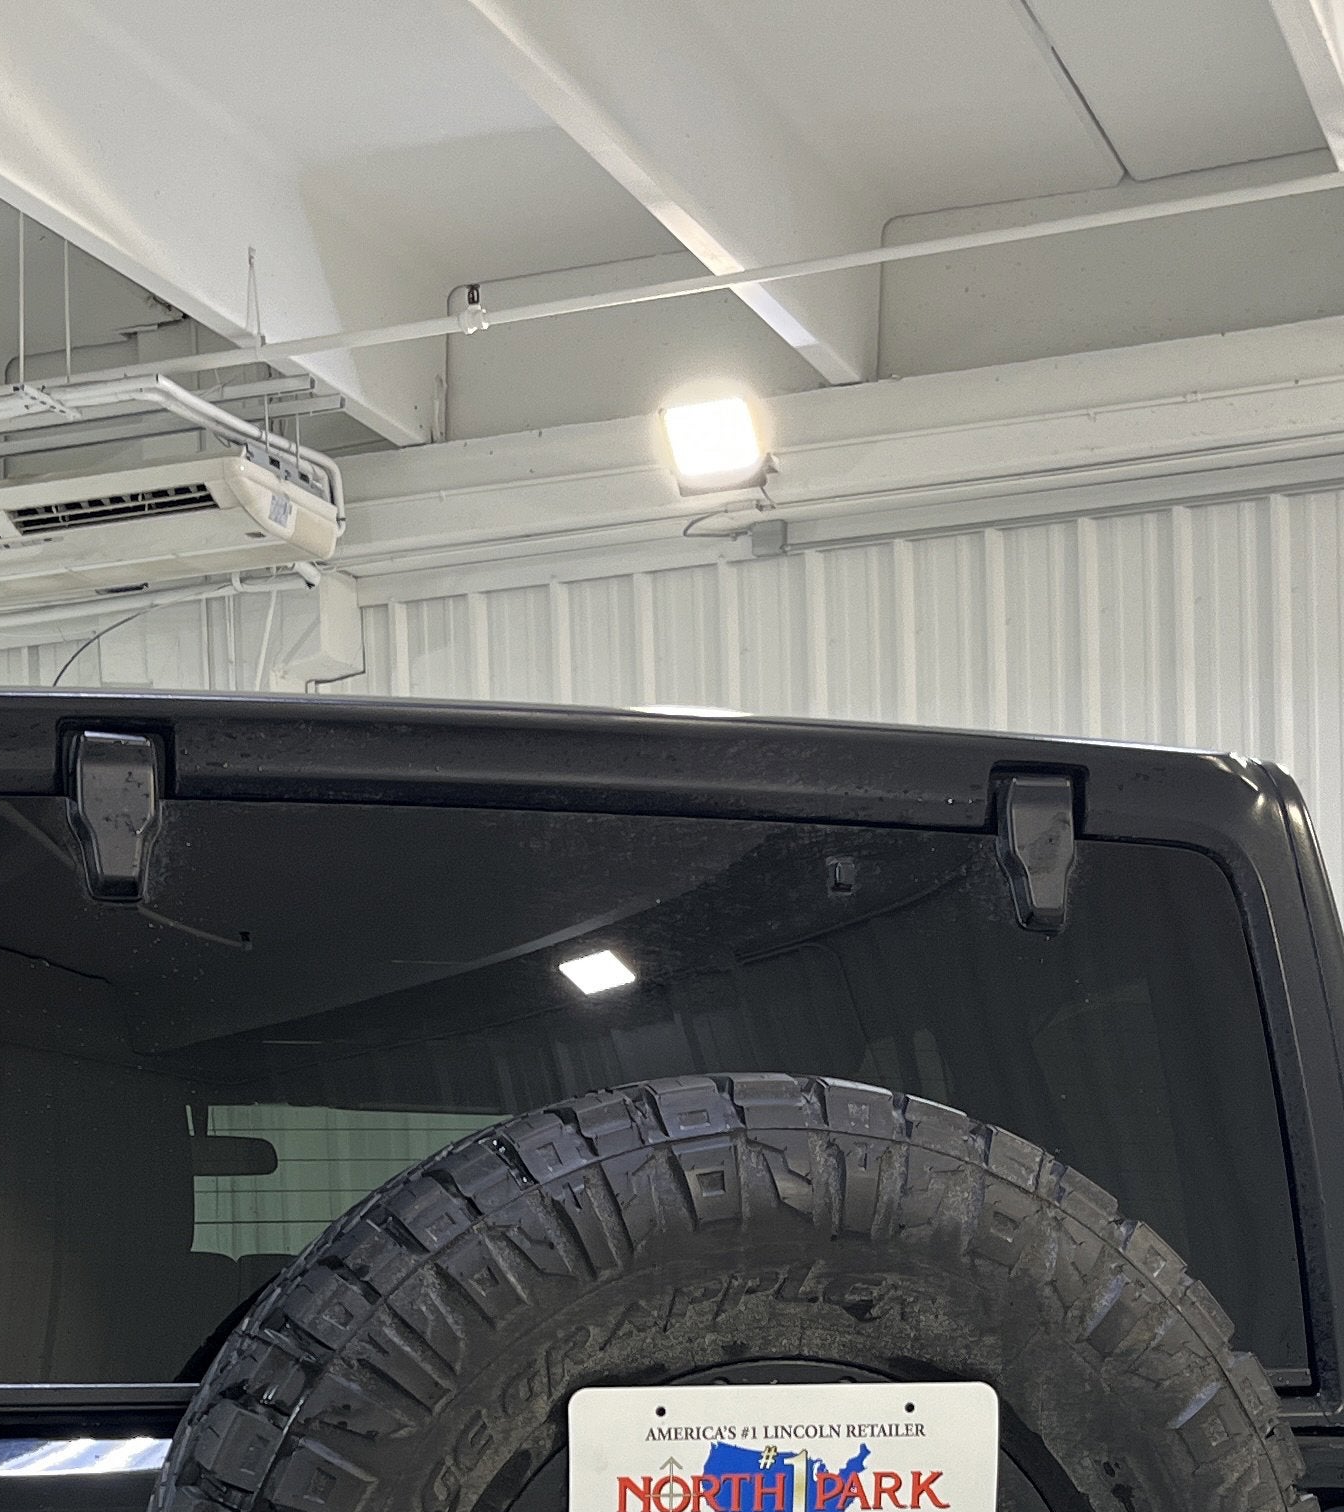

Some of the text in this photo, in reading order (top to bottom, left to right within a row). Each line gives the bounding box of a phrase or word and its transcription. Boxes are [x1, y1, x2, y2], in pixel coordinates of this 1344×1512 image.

[645, 1422, 926, 1442] AMERICA'S #1 LINCOLN RETAILER
[814, 1470, 951, 1512] PARK
